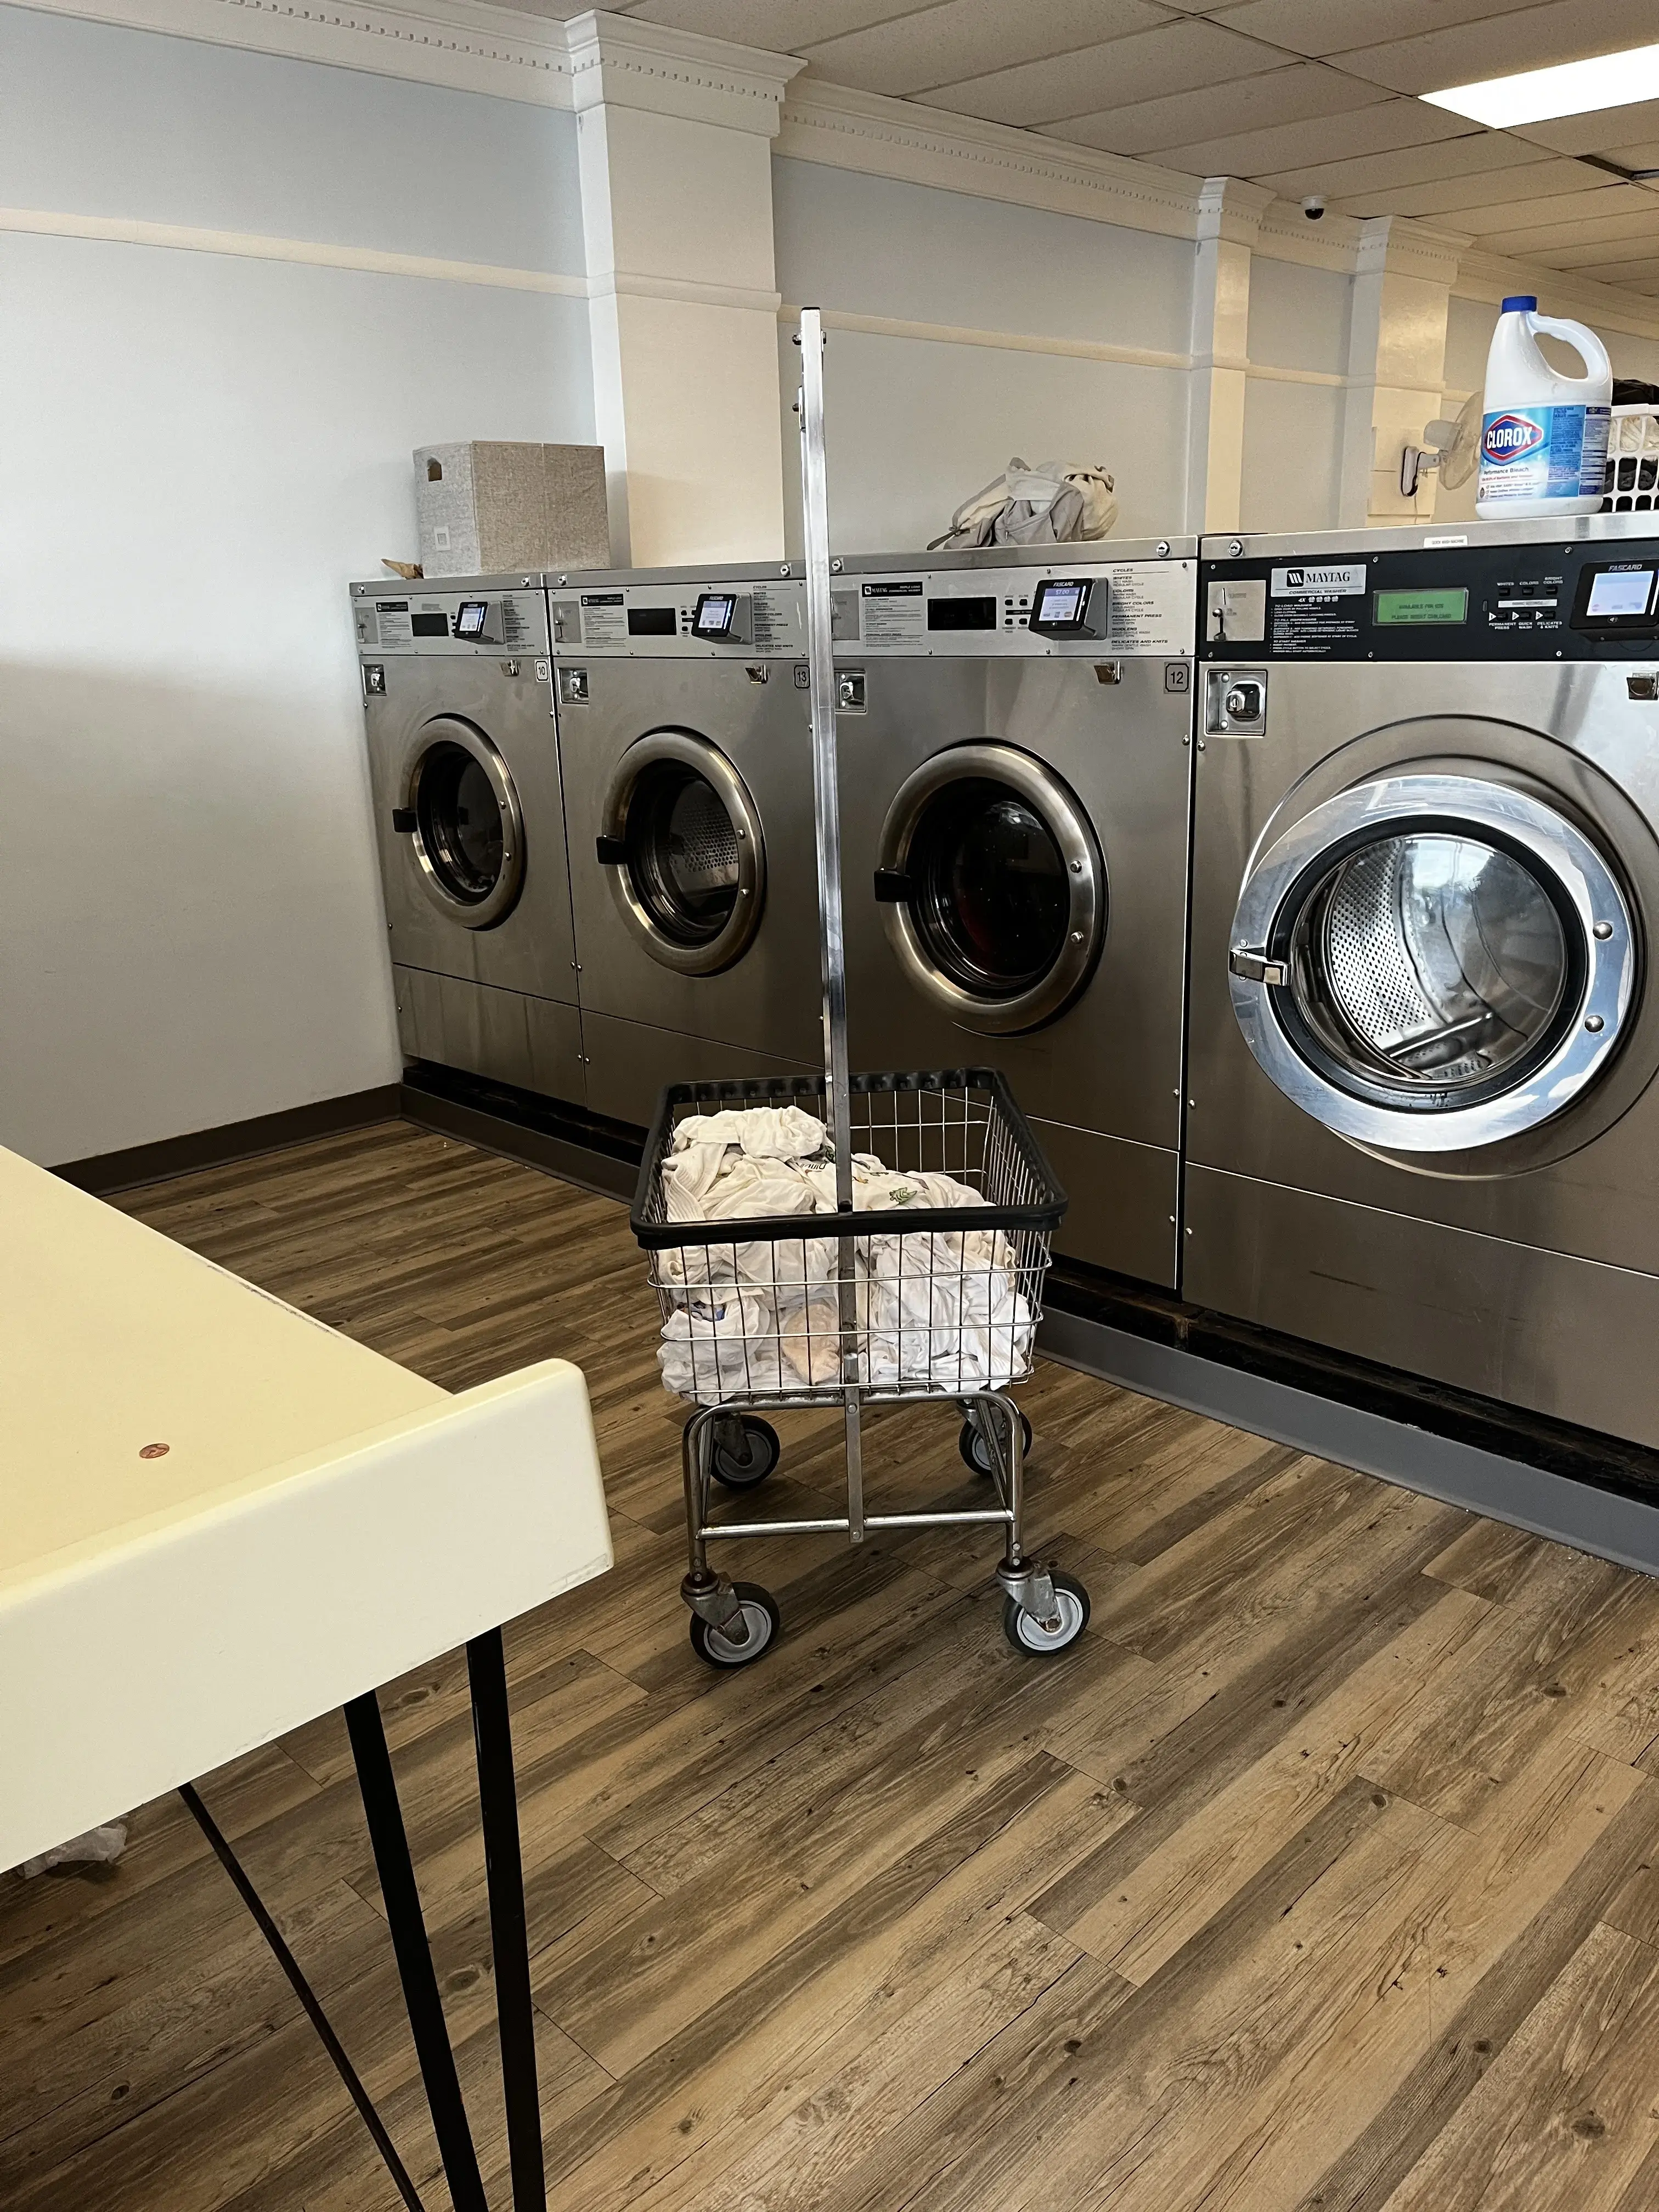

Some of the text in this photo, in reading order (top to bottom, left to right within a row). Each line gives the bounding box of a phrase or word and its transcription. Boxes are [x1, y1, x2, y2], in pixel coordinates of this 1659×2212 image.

[1487, 426, 1532, 449] CLOROX
[1306, 572, 1350, 583] MAYTAG
[538, 666, 545, 675] 10
[797, 671, 806, 682] 13
[1170, 671, 1183, 684] 12
